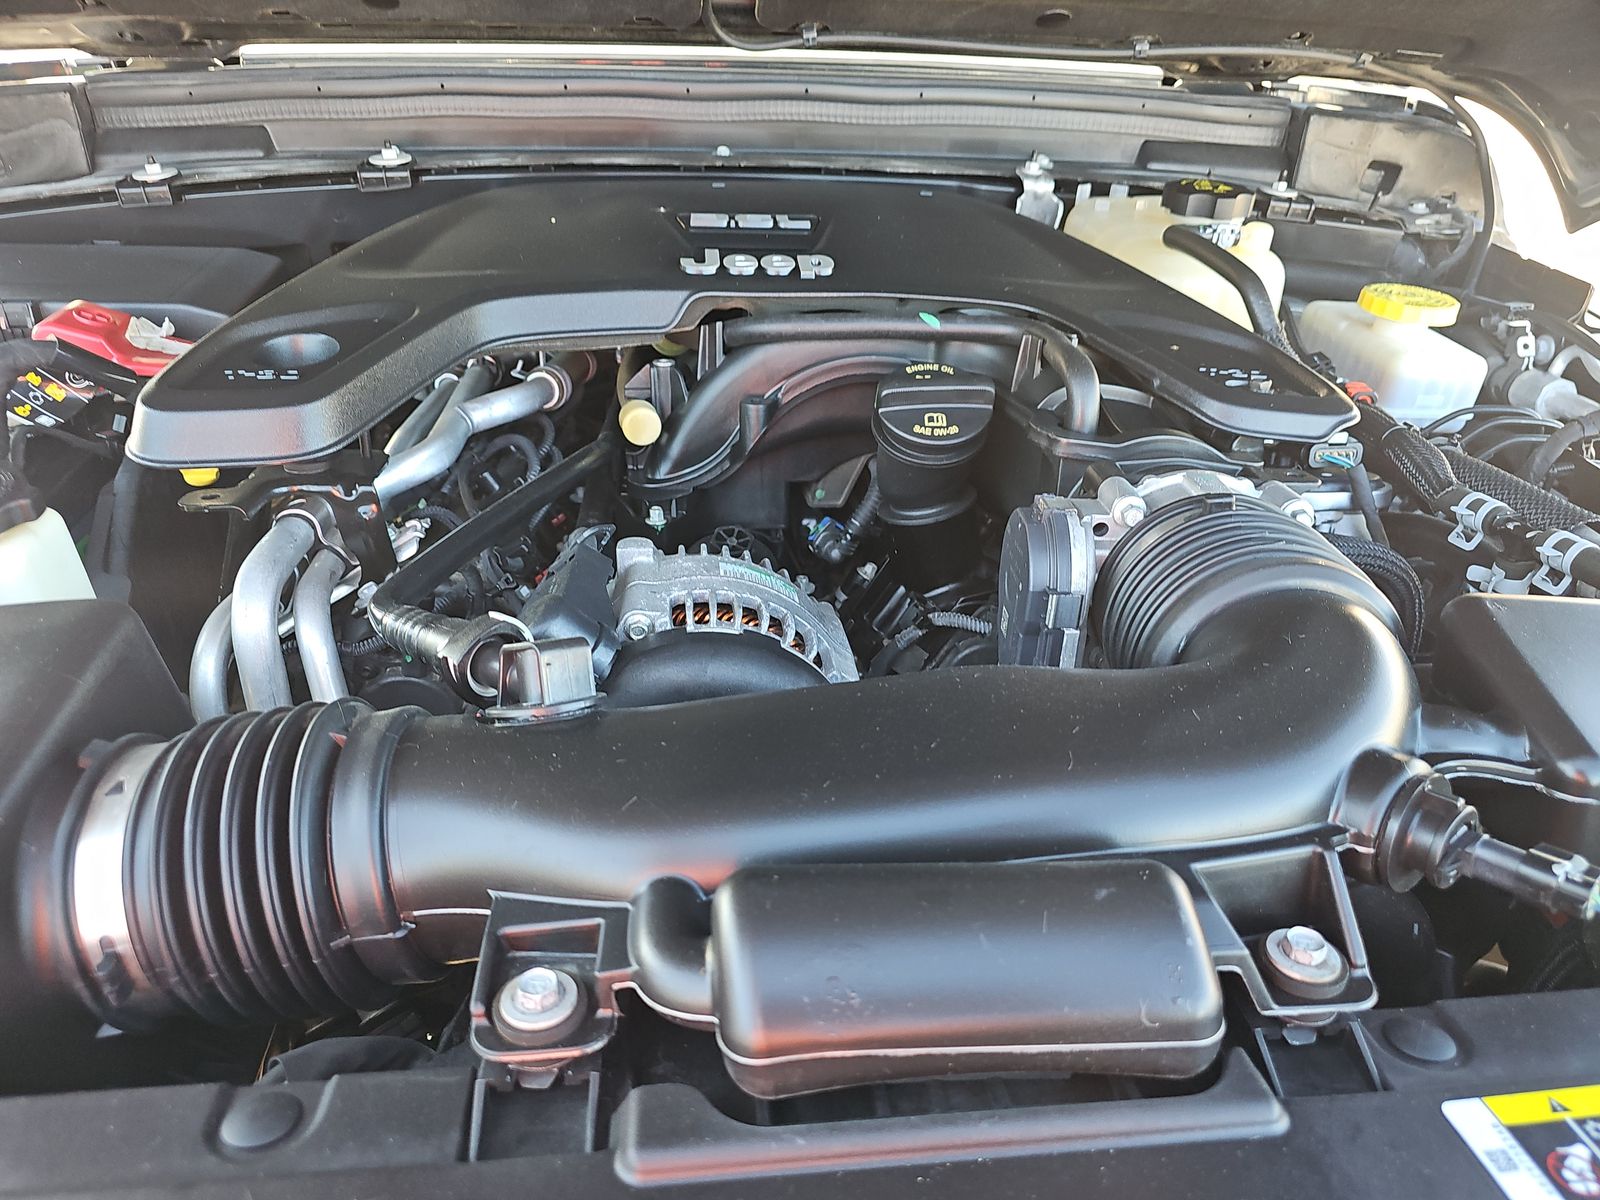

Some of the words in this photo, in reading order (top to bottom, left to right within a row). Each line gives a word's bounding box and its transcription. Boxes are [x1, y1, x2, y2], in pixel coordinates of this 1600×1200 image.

[679, 248, 835, 280] Jeep
[906, 364, 939, 374] ENGINE
[941, 365, 955, 375] OIL
[913, 424, 932, 436] SAE
